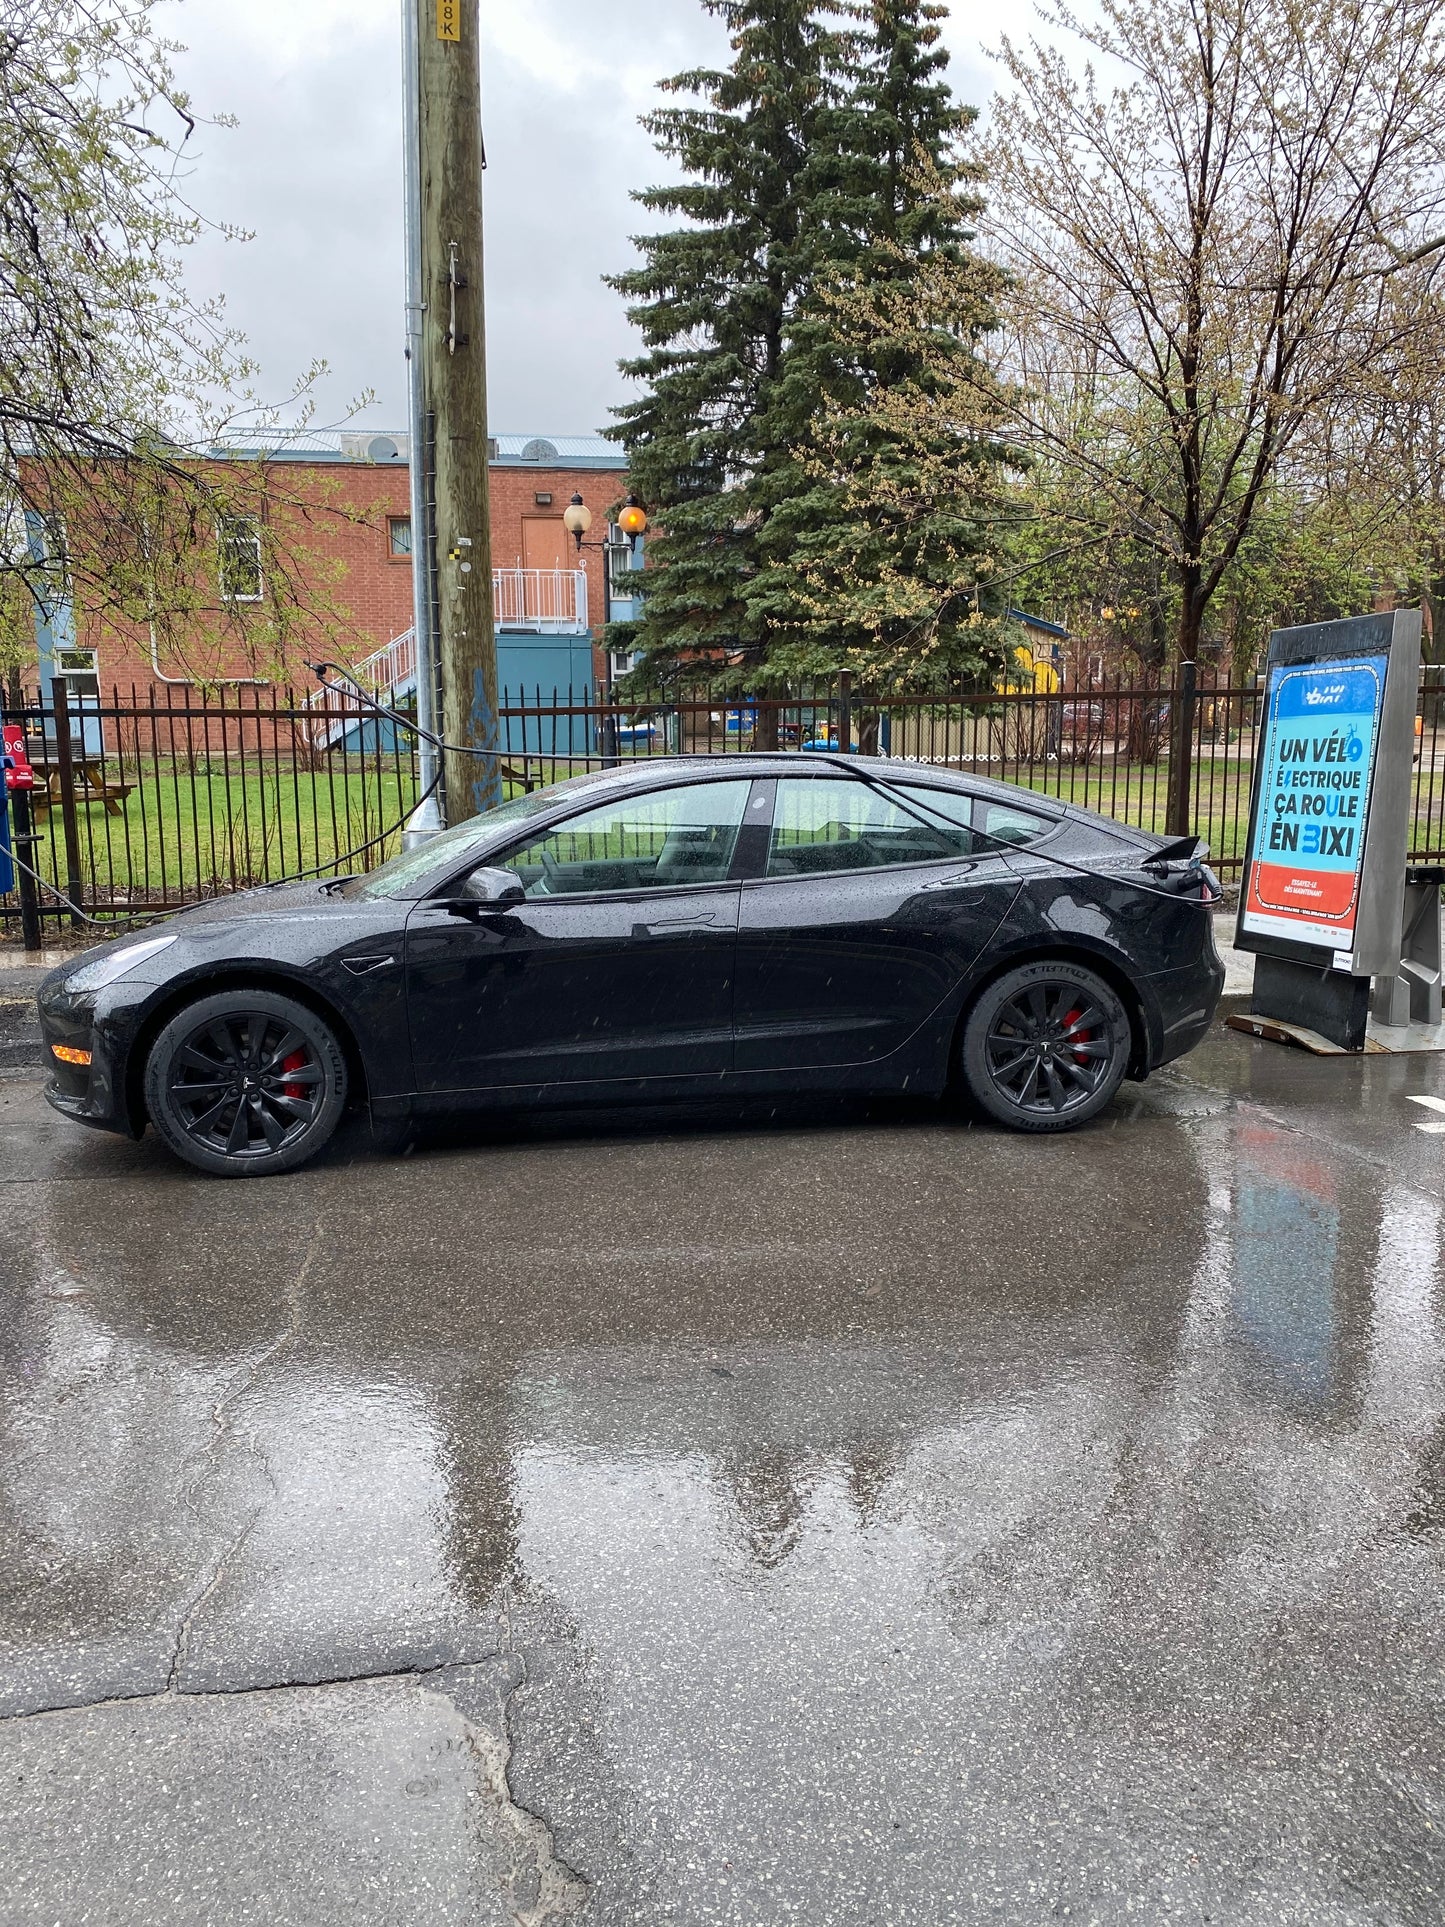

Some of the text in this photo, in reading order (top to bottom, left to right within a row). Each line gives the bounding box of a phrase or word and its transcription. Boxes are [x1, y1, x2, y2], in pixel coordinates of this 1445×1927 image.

[1280, 726, 1363, 762] UN VÉLO
[1274, 793, 1297, 821] ÇA
[1301, 794, 1359, 818] ROULE
[1269, 821, 1300, 852] EN
[1301, 824, 1355, 857] BIXI
[1283, 885, 1324, 897] DÈS MAINTENANT
[1291, 878, 1318, 889] ESSAYEZ-LE
